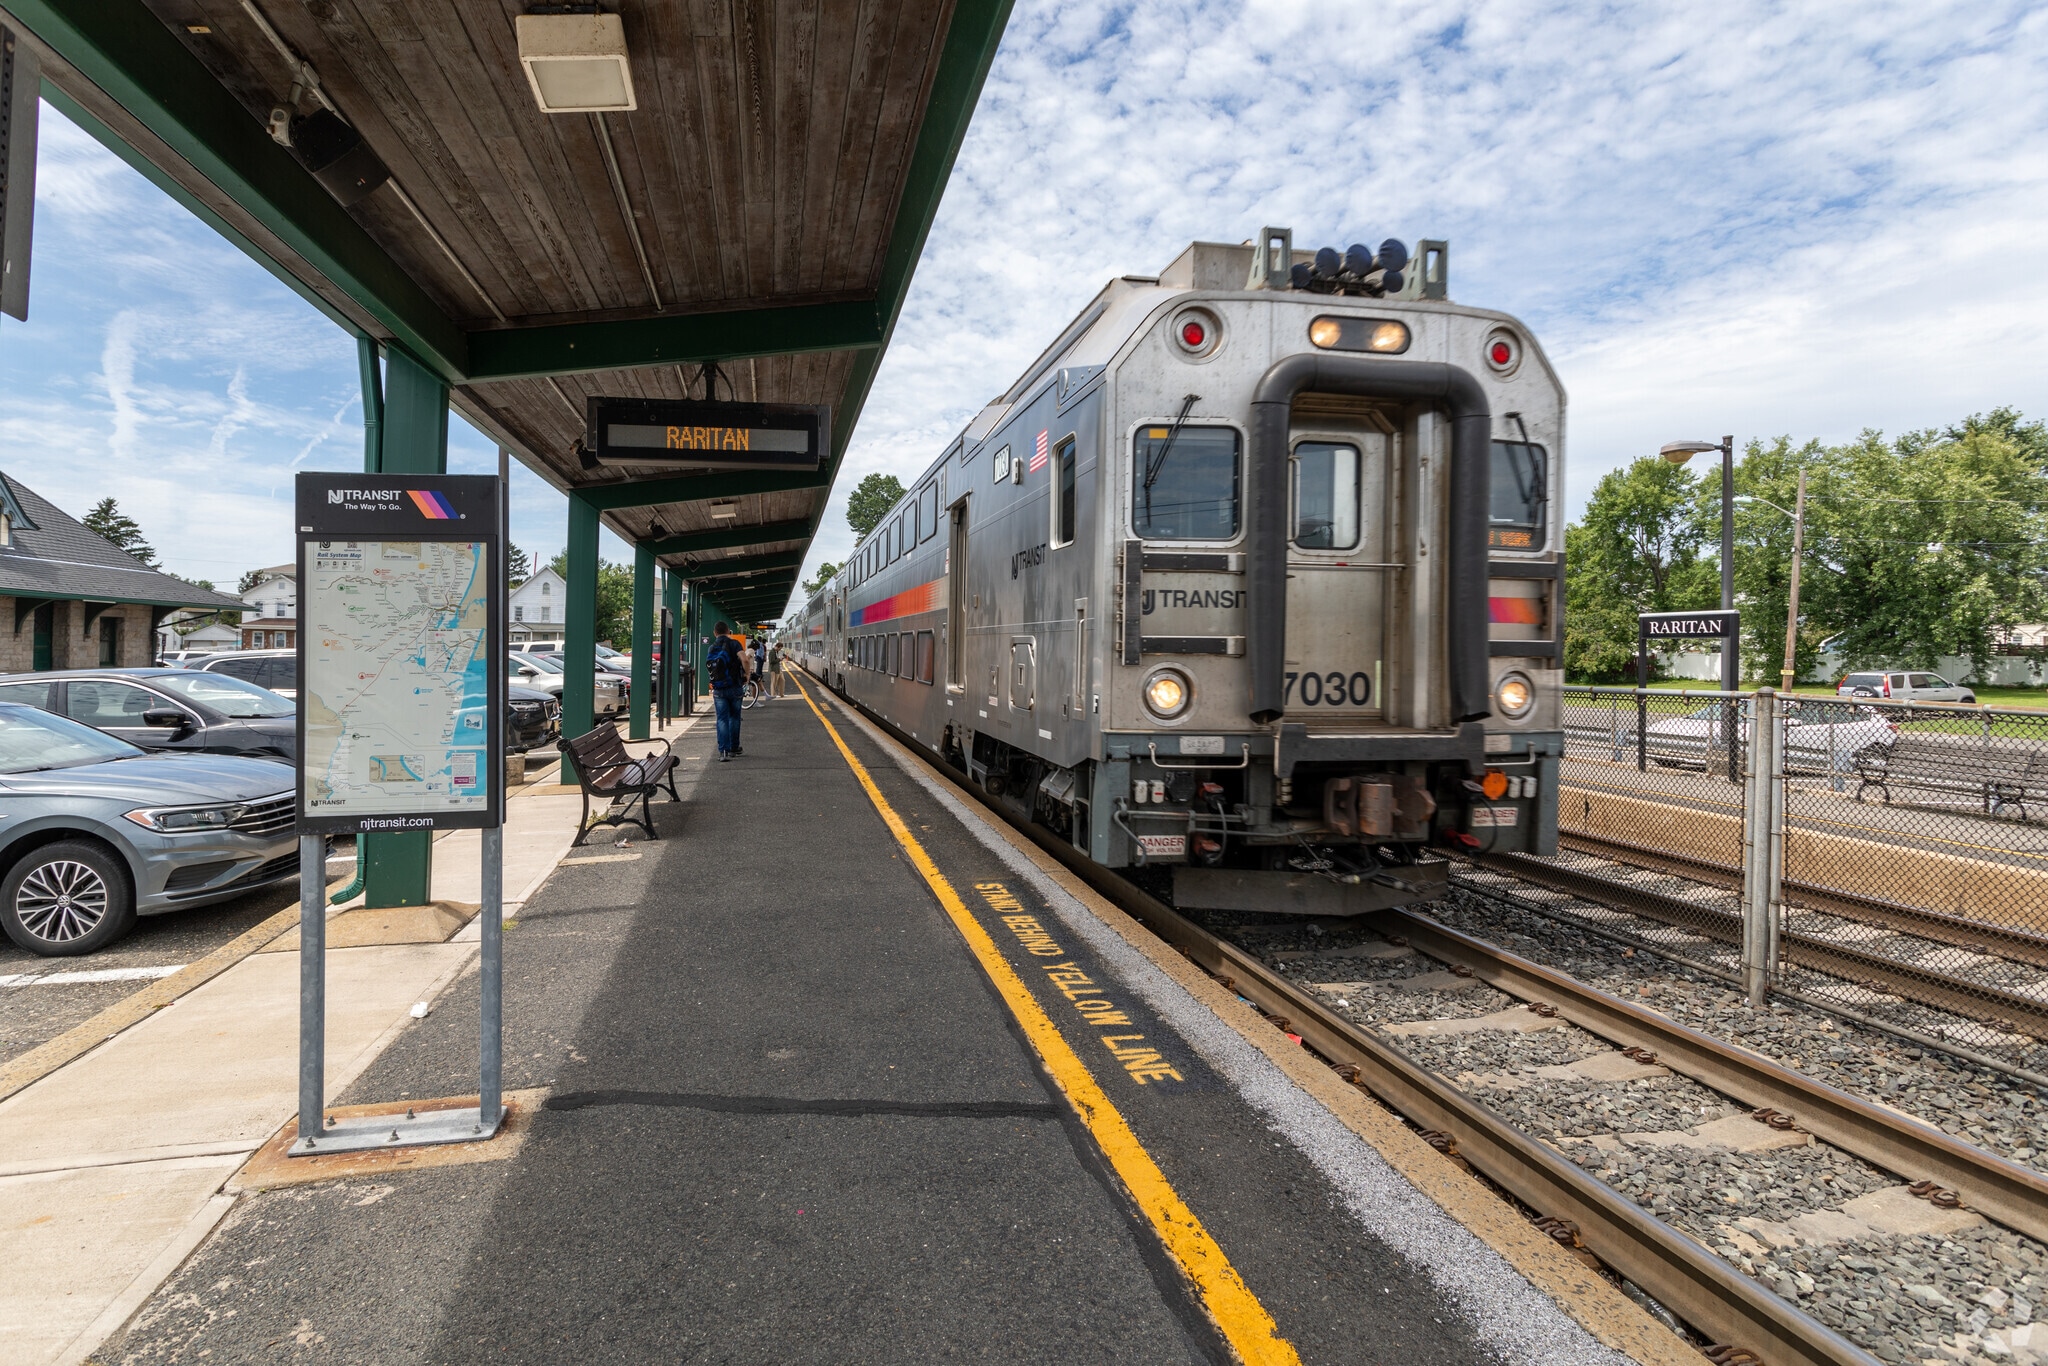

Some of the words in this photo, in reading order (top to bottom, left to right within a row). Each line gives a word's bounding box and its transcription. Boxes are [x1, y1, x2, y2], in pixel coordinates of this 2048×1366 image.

[666, 425, 749, 451] RARITAN
[360, 503, 376, 511] Way
[1649, 619, 1722, 635] RARITAN
[1284, 671, 1371, 706] 7030
[360, 817, 434, 831] njtransit.com
[975, 882, 1024, 913] STAND
[1002, 915, 1064, 957] BEHIND
[1042, 961, 1133, 1026] YELLOW
[1101, 1034, 1185, 1085] LINE
